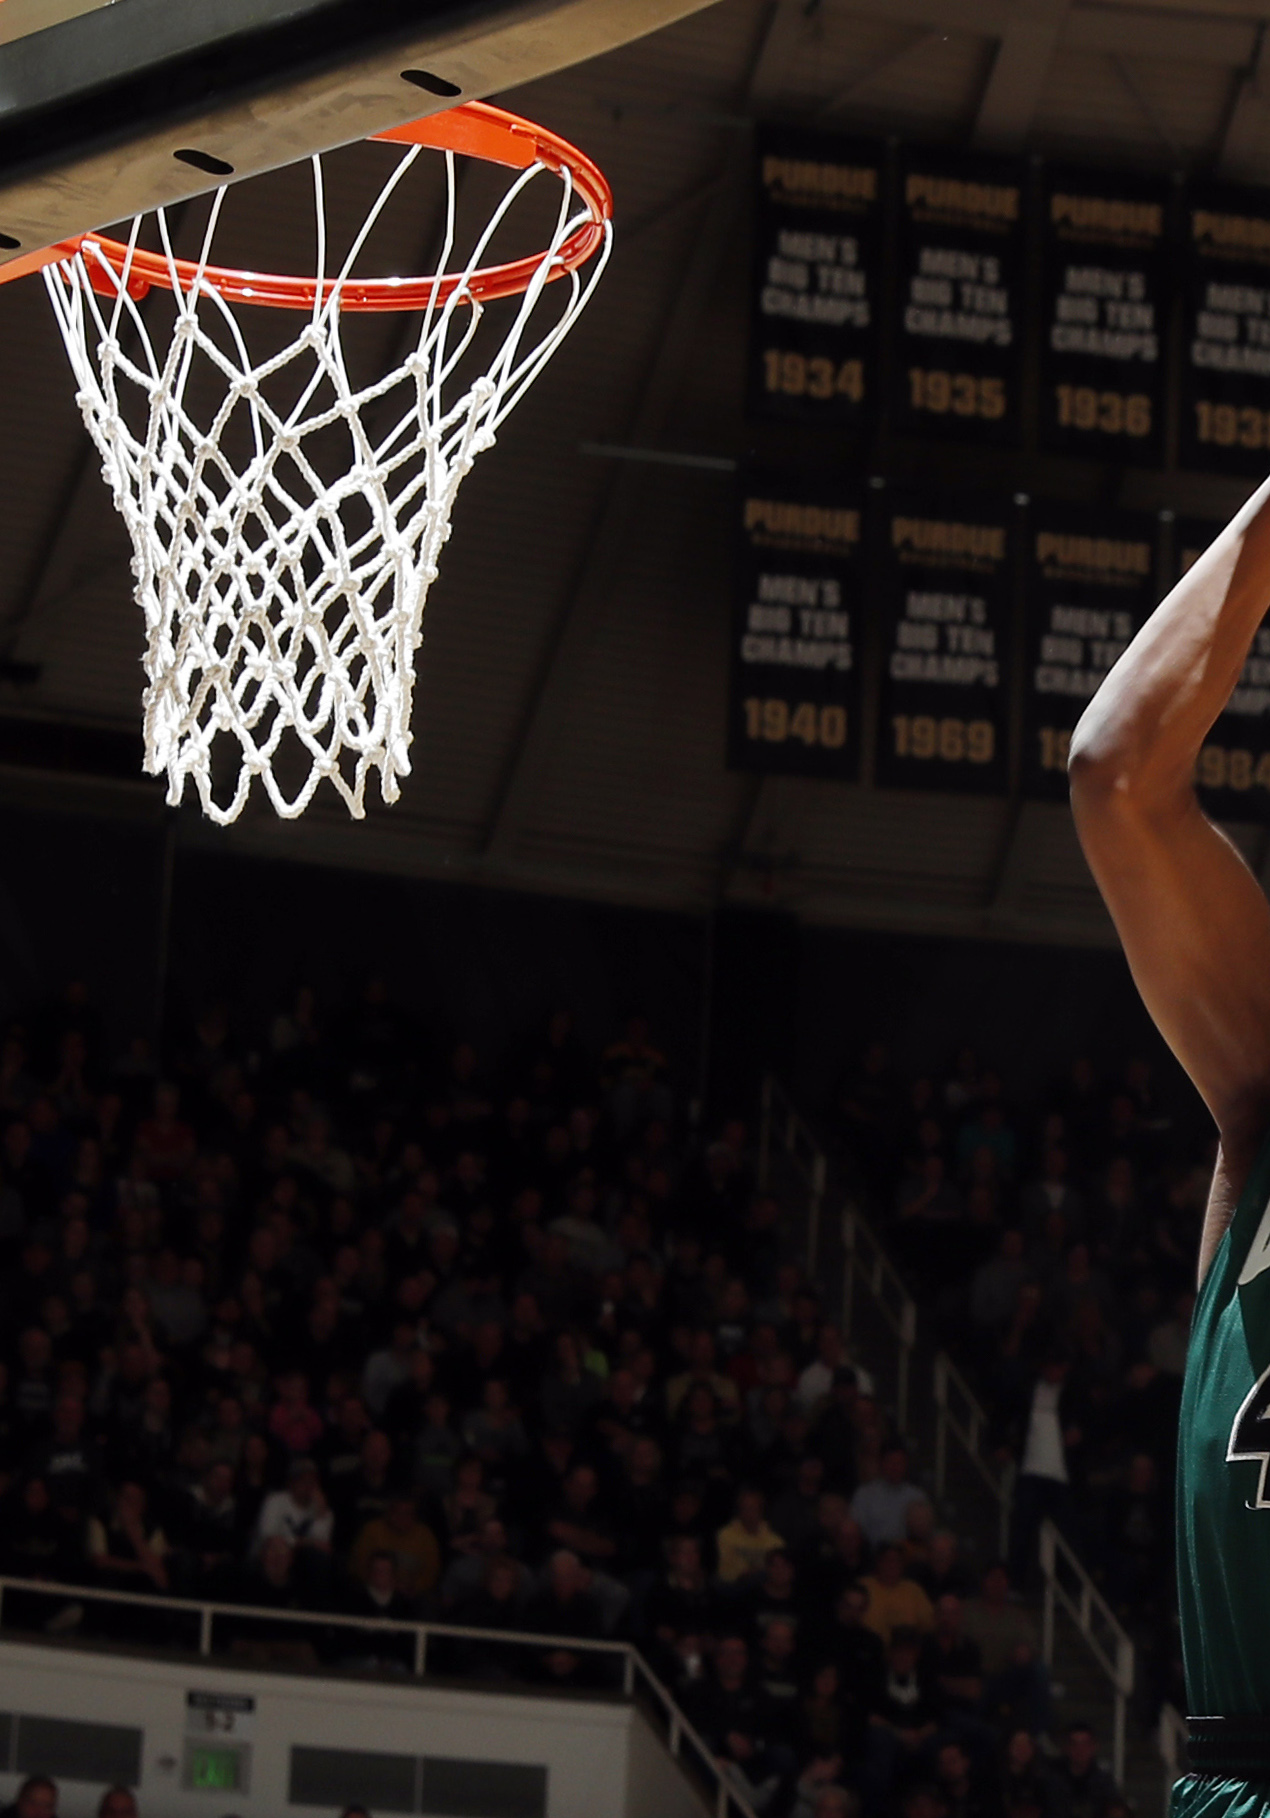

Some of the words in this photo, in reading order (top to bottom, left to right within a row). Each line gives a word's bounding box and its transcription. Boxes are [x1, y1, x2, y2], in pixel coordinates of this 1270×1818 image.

[762, 154, 878, 200] PURDUE
[905, 173, 1020, 222] PURDUE
[1051, 192, 1164, 237] PURDUE
[817, 263, 866, 296] TEN
[960, 281, 1008, 315] TEN
[760, 284, 871, 329] CHAMPS
[904, 303, 1013, 348] CHAMPS
[1105, 300, 1155, 331] TEN
[1051, 322, 1159, 362] CHAMPS
[763, 347, 865, 403] 1934
[908, 364, 1006, 421] 1935
[1055, 382, 1152, 438] 1936
[743, 497, 861, 544] PURDUE
[891, 515, 1006, 561] PURDUE
[1035, 530, 1151, 576] PURDUE
[800, 608, 850, 640] TEN
[946, 622, 995, 657] TEN
[741, 630, 853, 672] CHAMPS
[889, 650, 999, 688] CHAMPS
[743, 695, 848, 750] 1940
[893, 714, 997, 765] 1969
